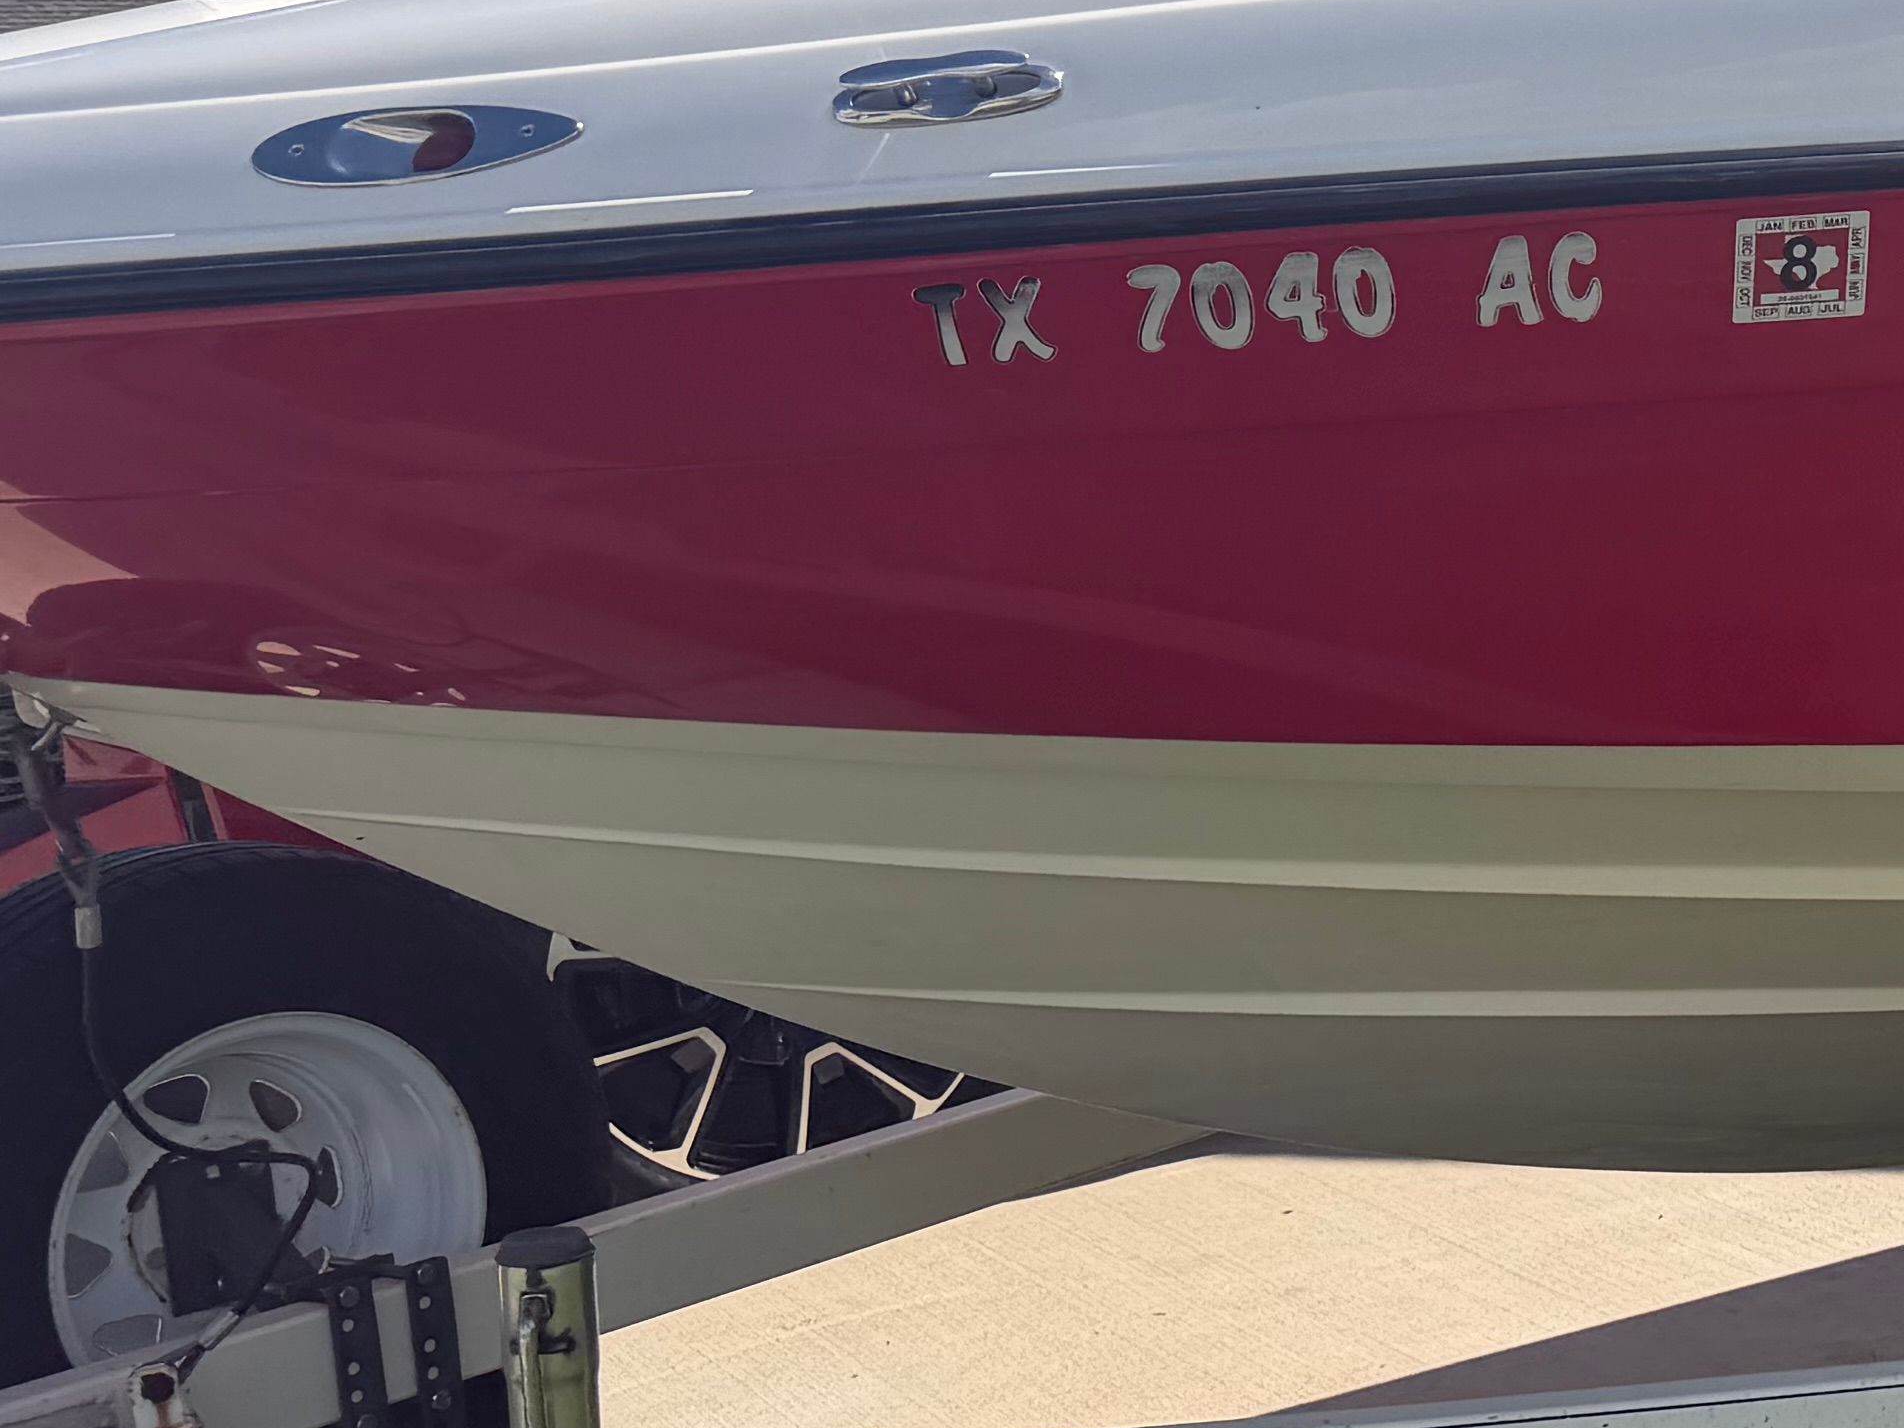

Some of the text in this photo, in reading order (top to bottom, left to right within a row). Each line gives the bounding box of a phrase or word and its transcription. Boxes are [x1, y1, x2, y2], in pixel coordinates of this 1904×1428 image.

[1757, 216, 1849, 232] JAN FEB MAR
[1741, 236, 1753, 256] DEC
[1850, 227, 1862, 249] APR
[1780, 235, 1818, 291] 8
[912, 231, 1604, 367] TX 7040 AC
[1739, 288, 1751, 306] OCT
[1754, 303, 1843, 318] SEP AUG JUL
